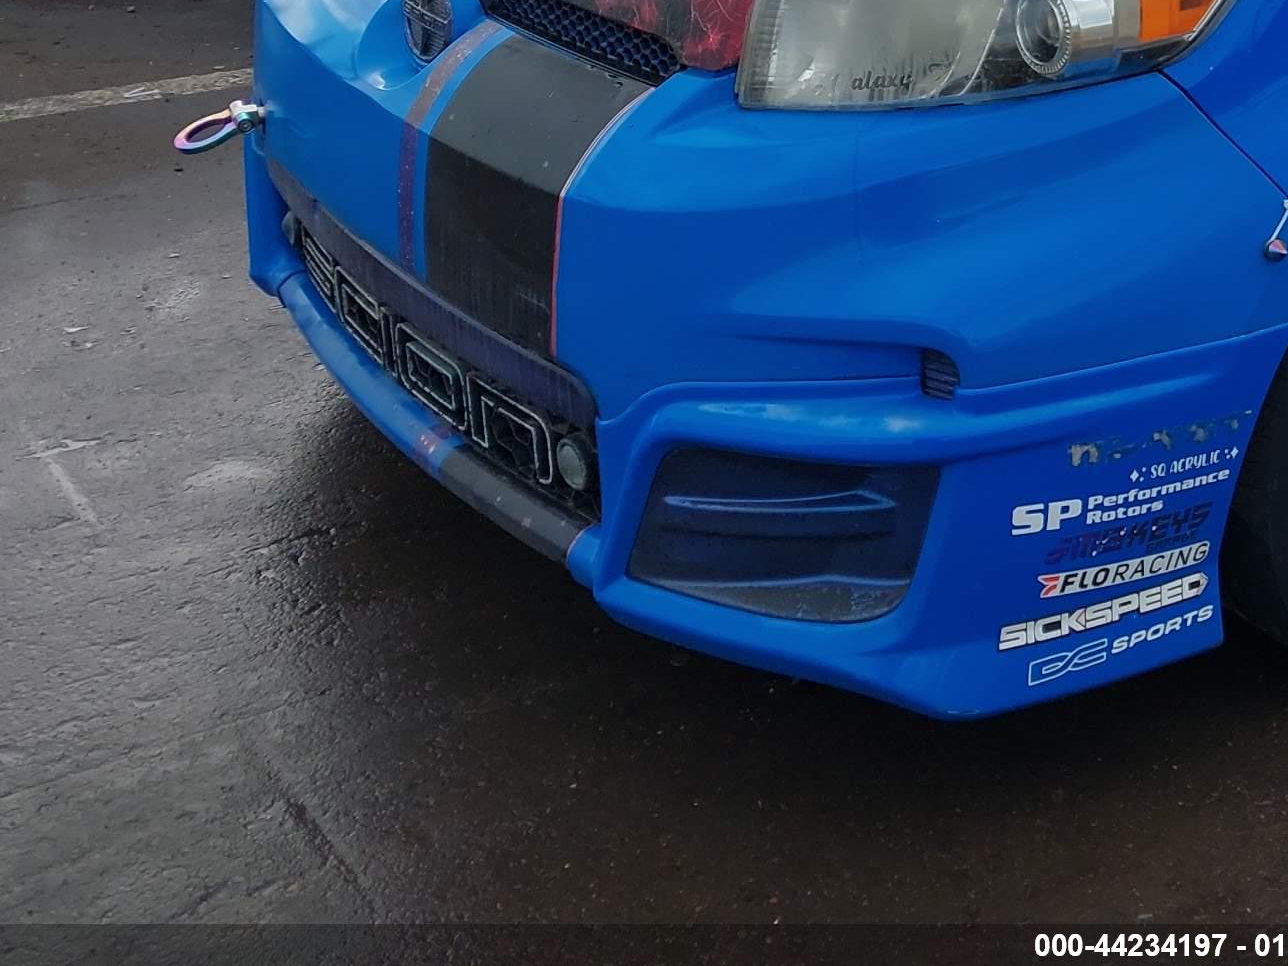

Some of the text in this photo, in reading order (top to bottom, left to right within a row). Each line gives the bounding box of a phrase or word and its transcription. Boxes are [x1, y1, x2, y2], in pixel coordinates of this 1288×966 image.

[843, 69, 914, 93] alaxy
[1169, 449, 1222, 475] ACRYLIC
[1011, 468, 1231, 536] SP Performance
[1086, 500, 1164, 525] Rotors
[1060, 543, 1209, 594] FLORACING
[999, 572, 1209, 651] SICKSPEED
[1111, 604, 1214, 654] SPORTS
